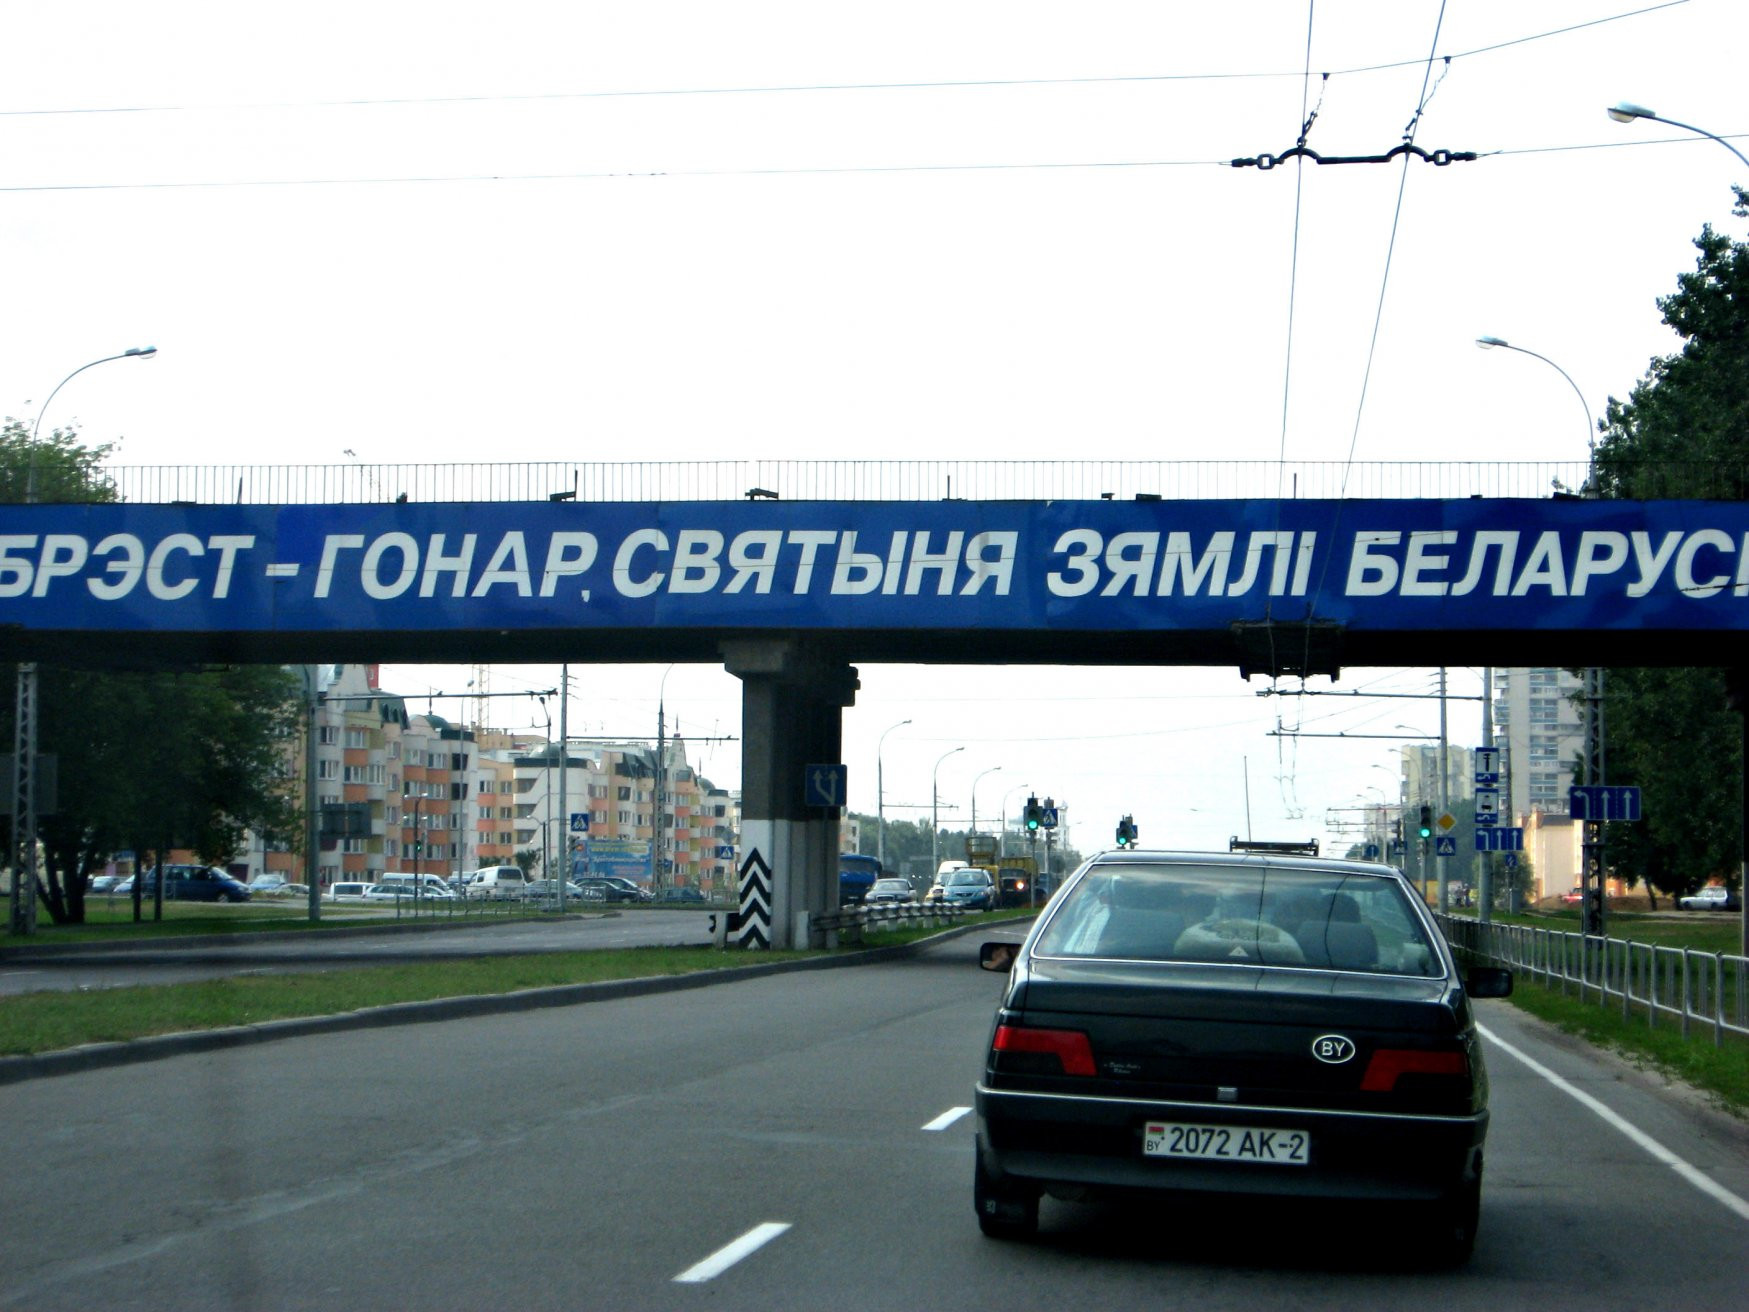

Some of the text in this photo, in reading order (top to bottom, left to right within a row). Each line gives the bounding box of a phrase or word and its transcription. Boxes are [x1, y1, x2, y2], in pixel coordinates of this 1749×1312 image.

[0, 533, 255, 600] БРЭСТ
[612, 528, 1018, 598] СВЯТЫНЯ
[1046, 529, 1316, 597] ЗЯМЛІ
[1322, 1041, 1345, 1056] BY
[1146, 1140, 1160, 1151] BY
[1170, 1126, 1304, 1160] 2072 AK-2
